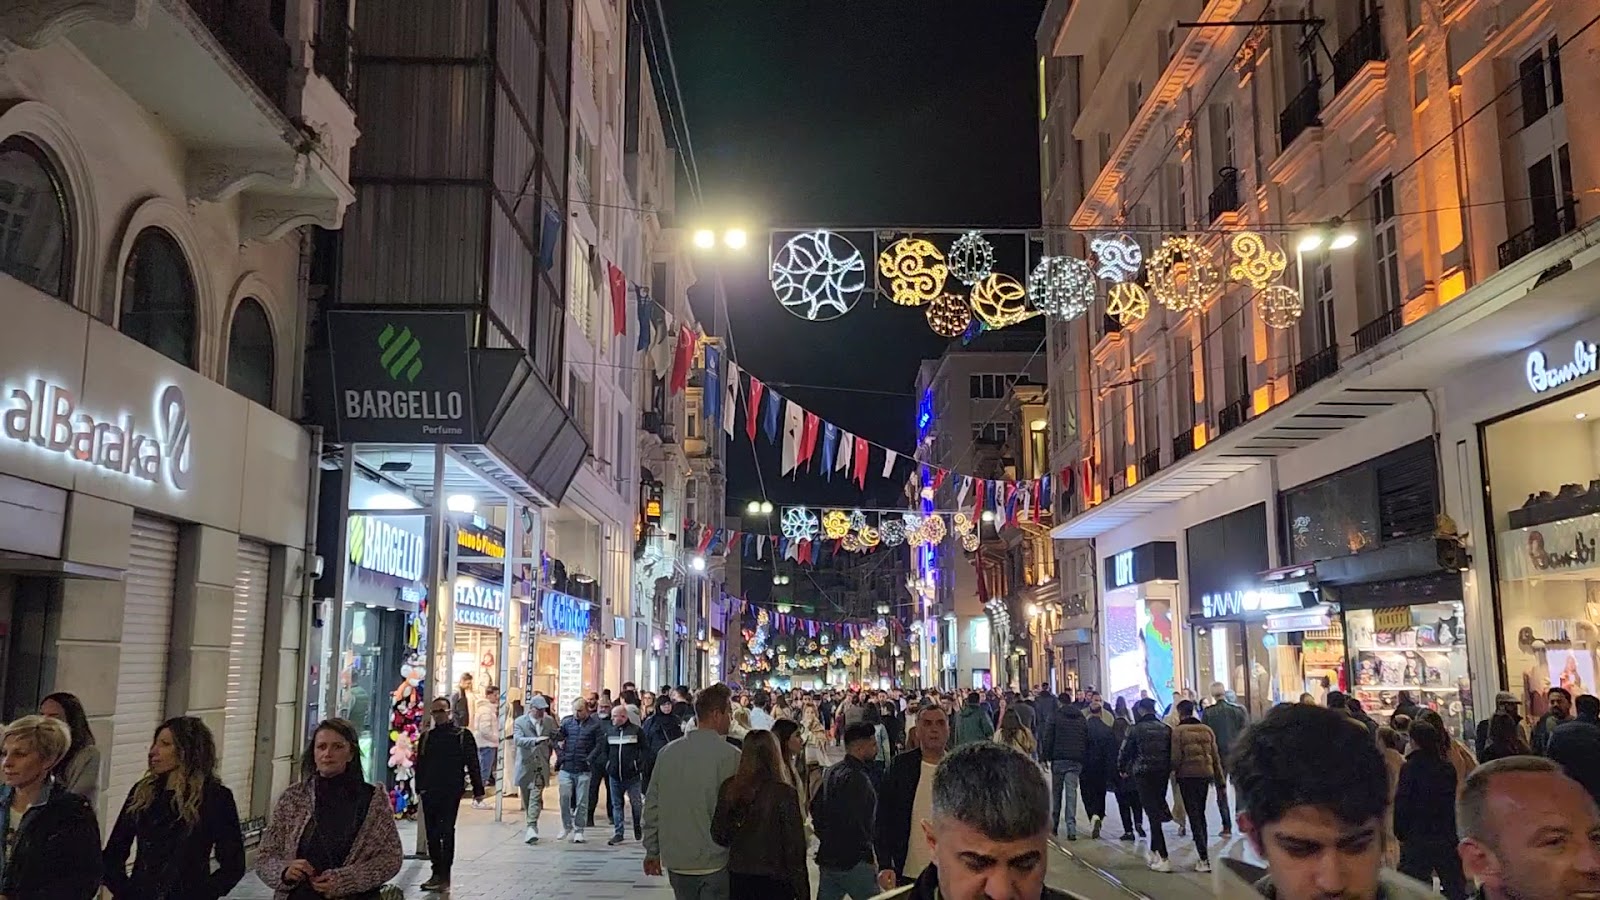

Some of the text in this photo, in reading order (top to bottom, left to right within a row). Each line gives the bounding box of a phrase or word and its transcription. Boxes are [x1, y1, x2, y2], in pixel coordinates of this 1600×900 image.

[1526, 340, 1597, 393] Bambi
[344, 389, 463, 419] BARGELLO
[422, 425, 463, 435] Perfume
[5, 379, 161, 483] alBaraka
[362, 514, 423, 582] BARGELLO
